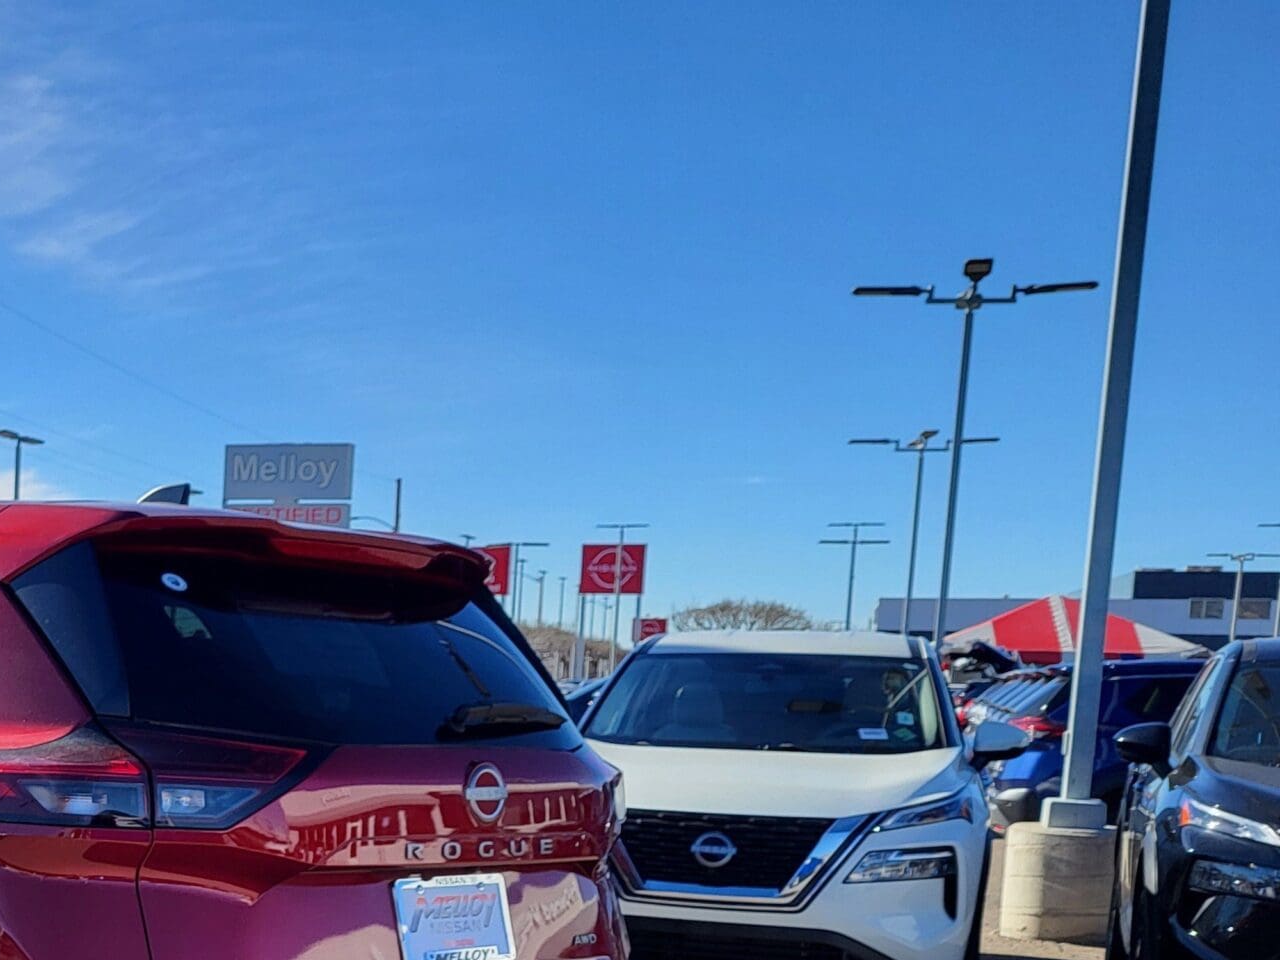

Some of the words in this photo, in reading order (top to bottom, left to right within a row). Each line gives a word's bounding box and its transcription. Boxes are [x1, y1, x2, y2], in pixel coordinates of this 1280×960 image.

[232, 452, 338, 489] Melloy
[406, 838, 554, 861] ROGUE
[410, 893, 496, 933] MELLOY
